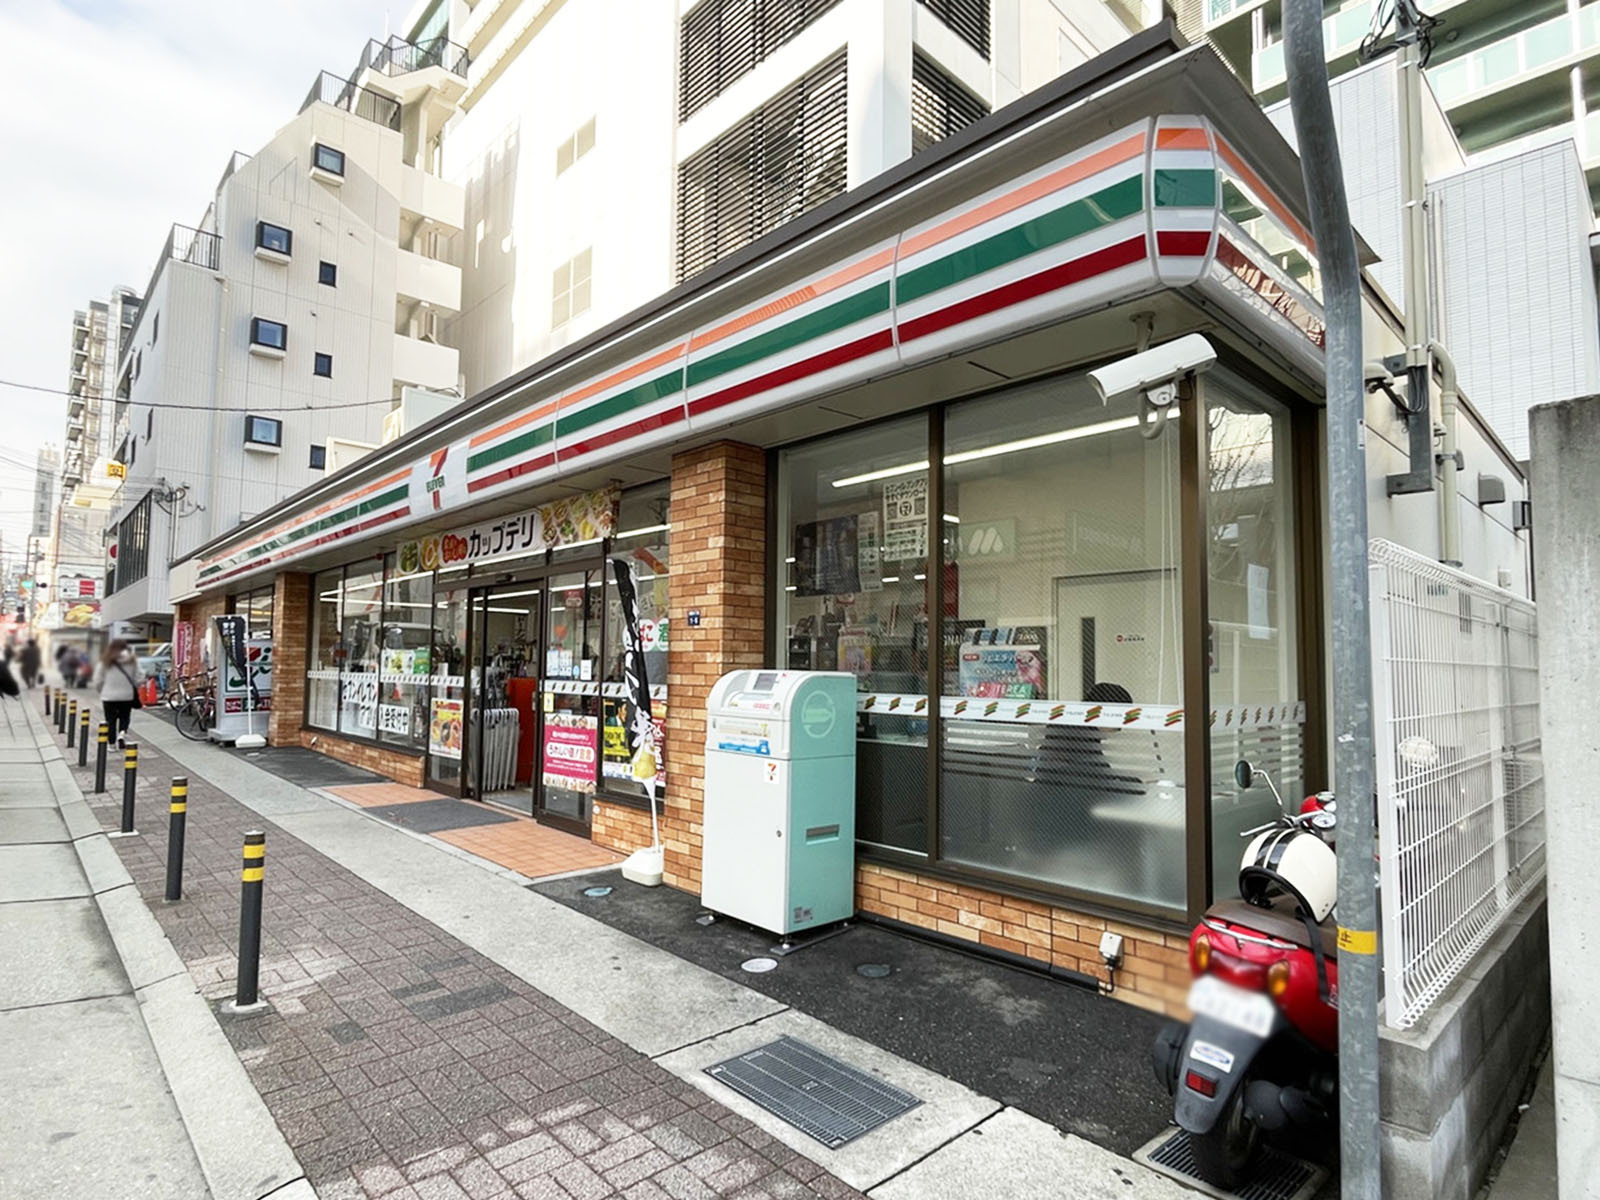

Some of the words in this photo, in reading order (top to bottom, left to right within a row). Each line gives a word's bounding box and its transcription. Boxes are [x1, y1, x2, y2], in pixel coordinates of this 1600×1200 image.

[469, 515, 534, 557] カップデリ
